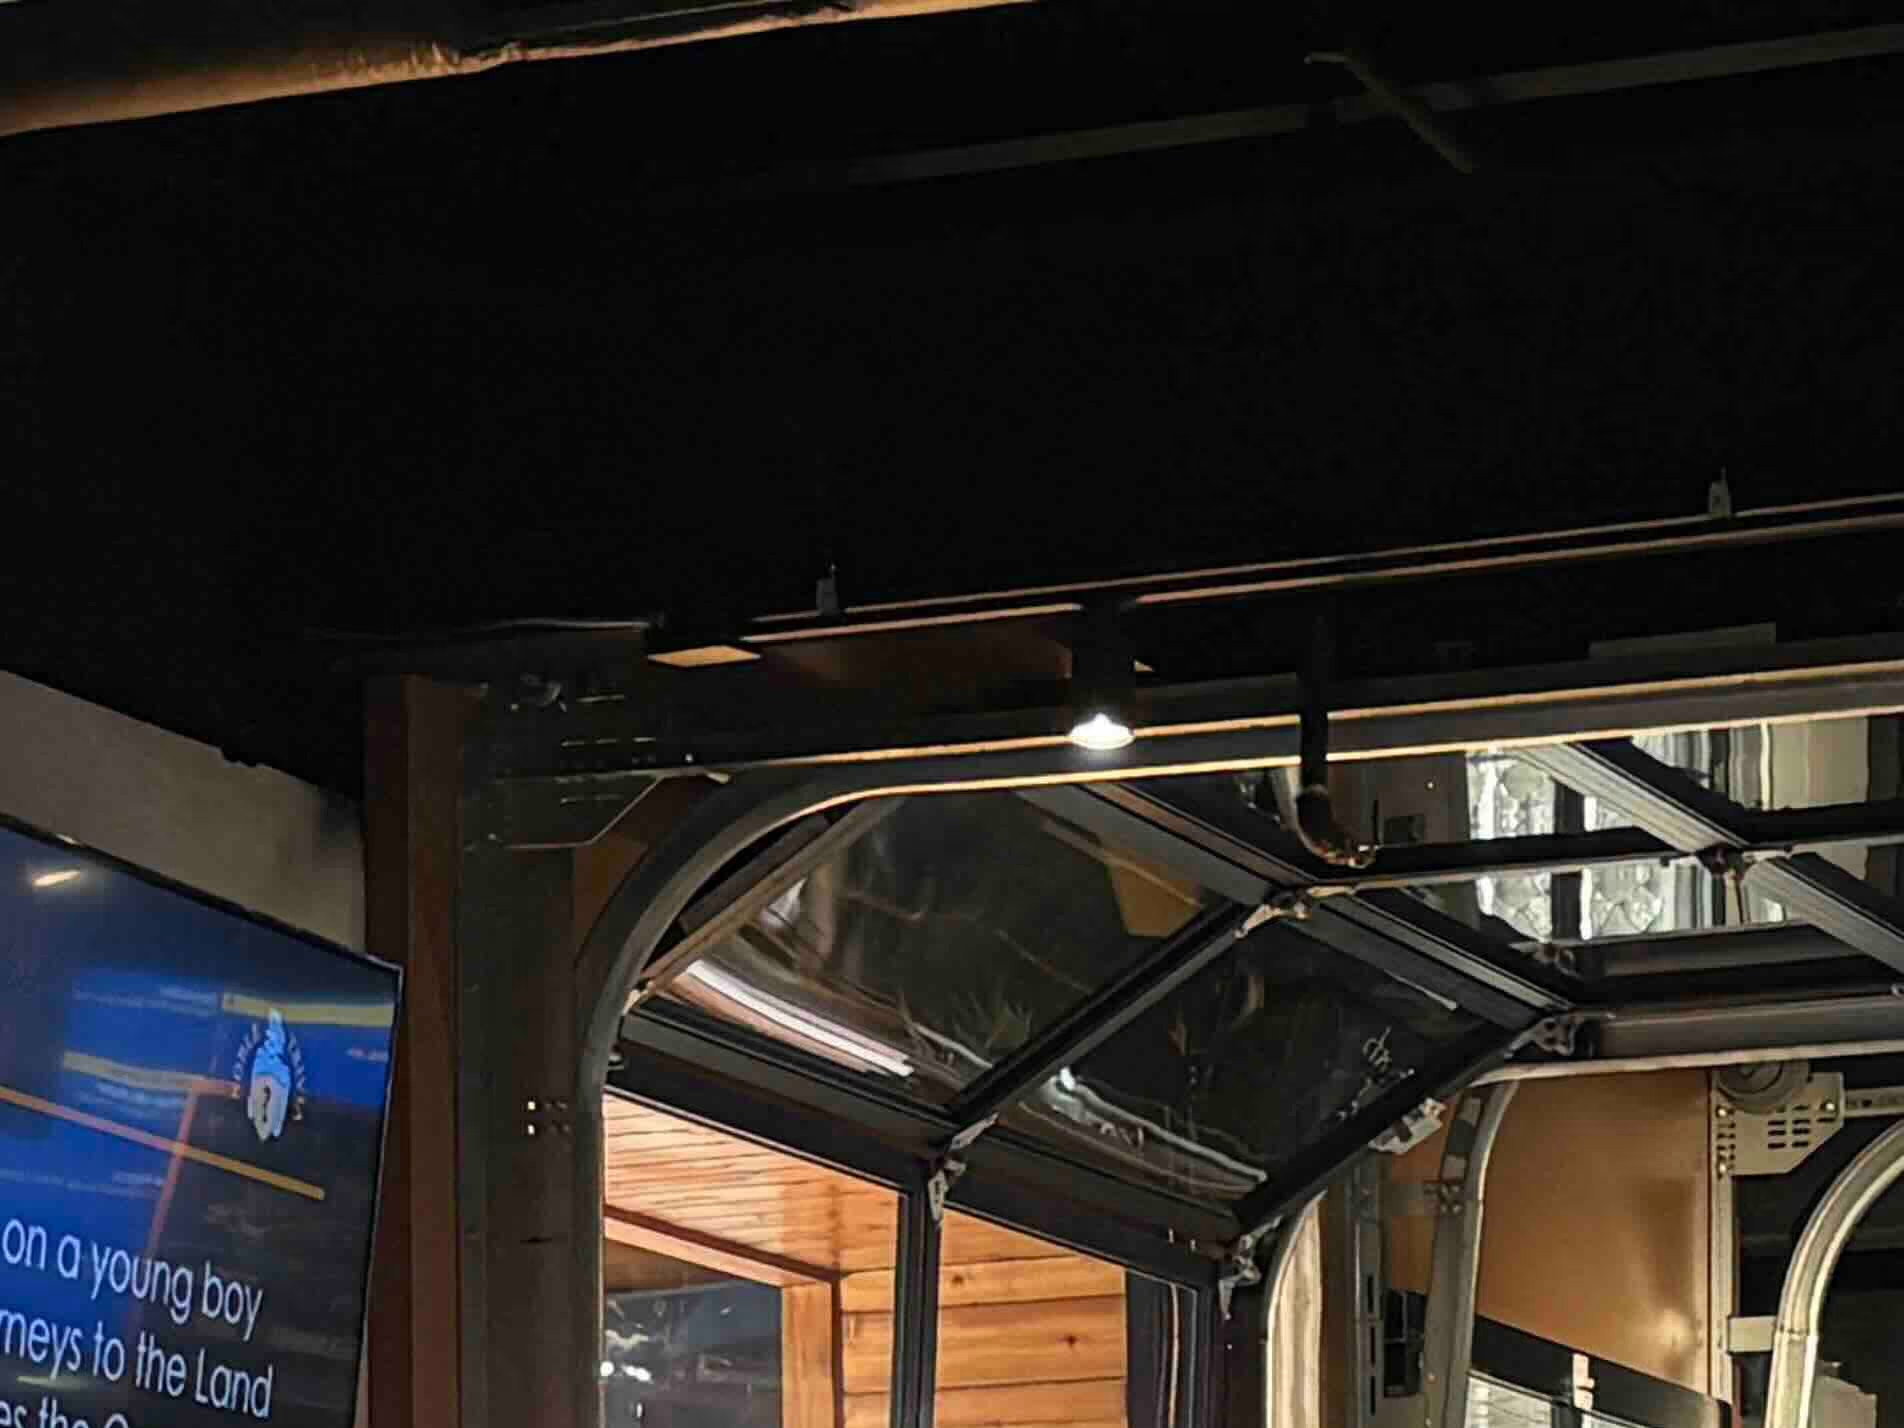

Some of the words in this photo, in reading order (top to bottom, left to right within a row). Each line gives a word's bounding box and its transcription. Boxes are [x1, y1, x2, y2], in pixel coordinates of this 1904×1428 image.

[2, 1220, 47, 1269] on
[57, 1235, 81, 1279] a
[90, 1241, 193, 1325] young
[202, 1261, 263, 1340] boy
[93, 1321, 125, 1381] to
[135, 1331, 186, 1396] the
[195, 1348, 273, 1418] Land
